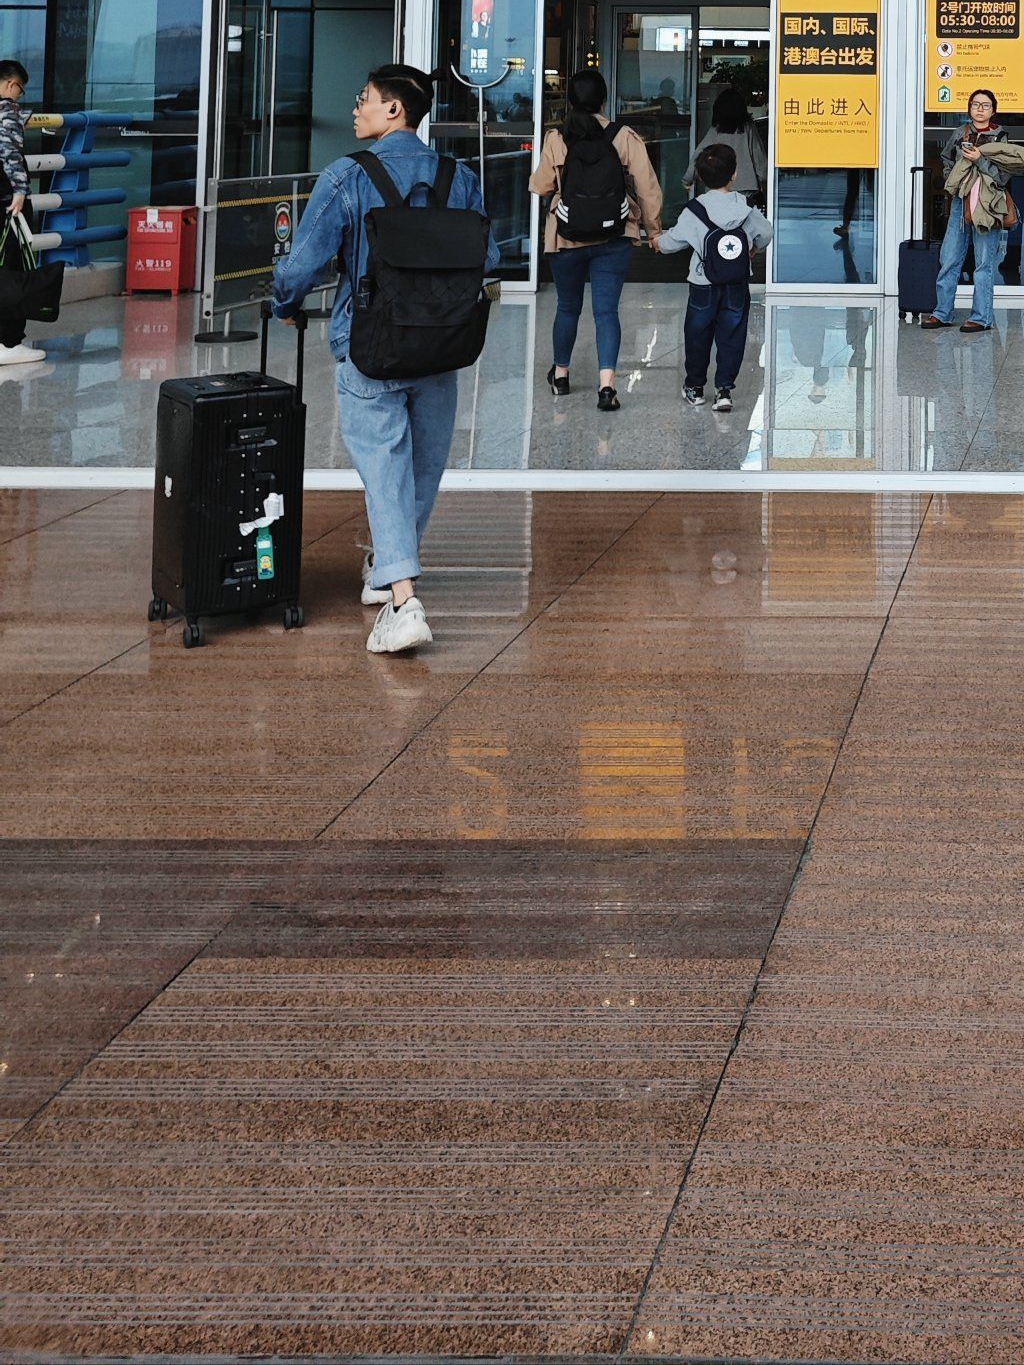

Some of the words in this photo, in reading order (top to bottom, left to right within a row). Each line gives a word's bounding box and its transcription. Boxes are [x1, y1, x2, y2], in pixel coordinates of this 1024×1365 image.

[940, 1, 1016, 14] 2号门开放时间
[940, 15, 1016, 26] 05:30-08:00
[783, 46, 875, 66] 港澳台出发
[783, 97, 872, 116] 由此进入
